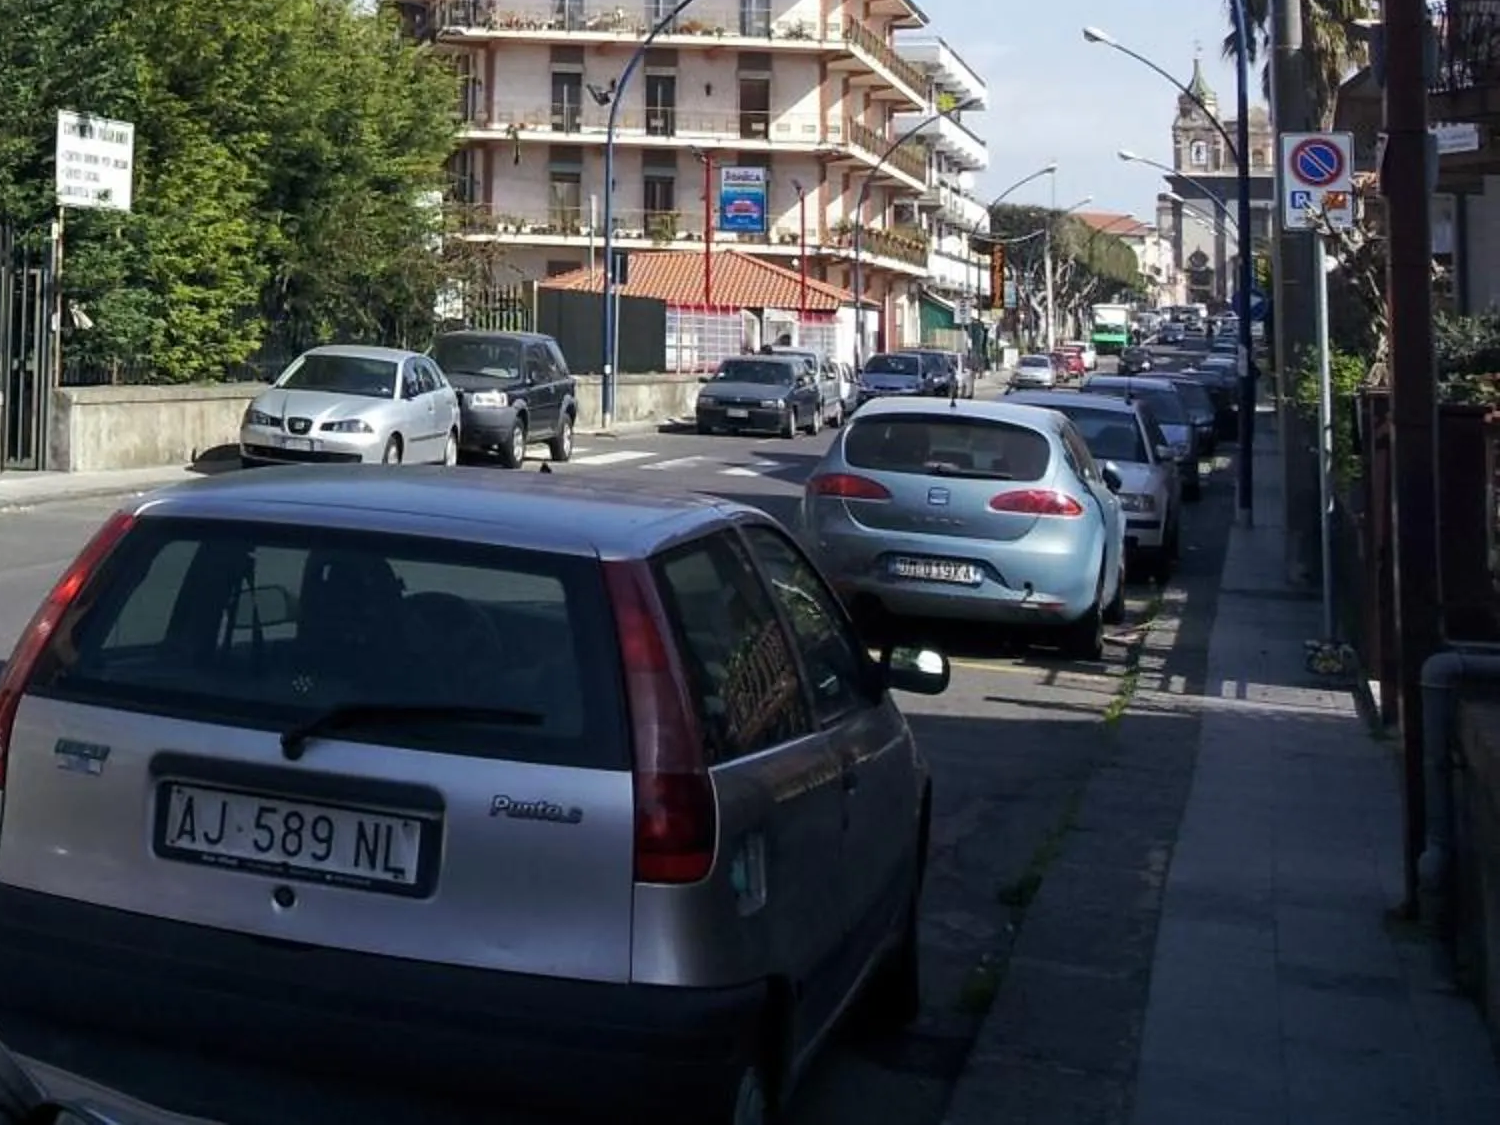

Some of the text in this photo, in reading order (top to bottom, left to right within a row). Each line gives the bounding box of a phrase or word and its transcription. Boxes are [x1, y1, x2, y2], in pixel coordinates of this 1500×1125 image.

[489, 794, 562, 821] Punto
[177, 795, 228, 845] AJ
[253, 806, 335, 862] 589
[353, 820, 406, 879] NL
